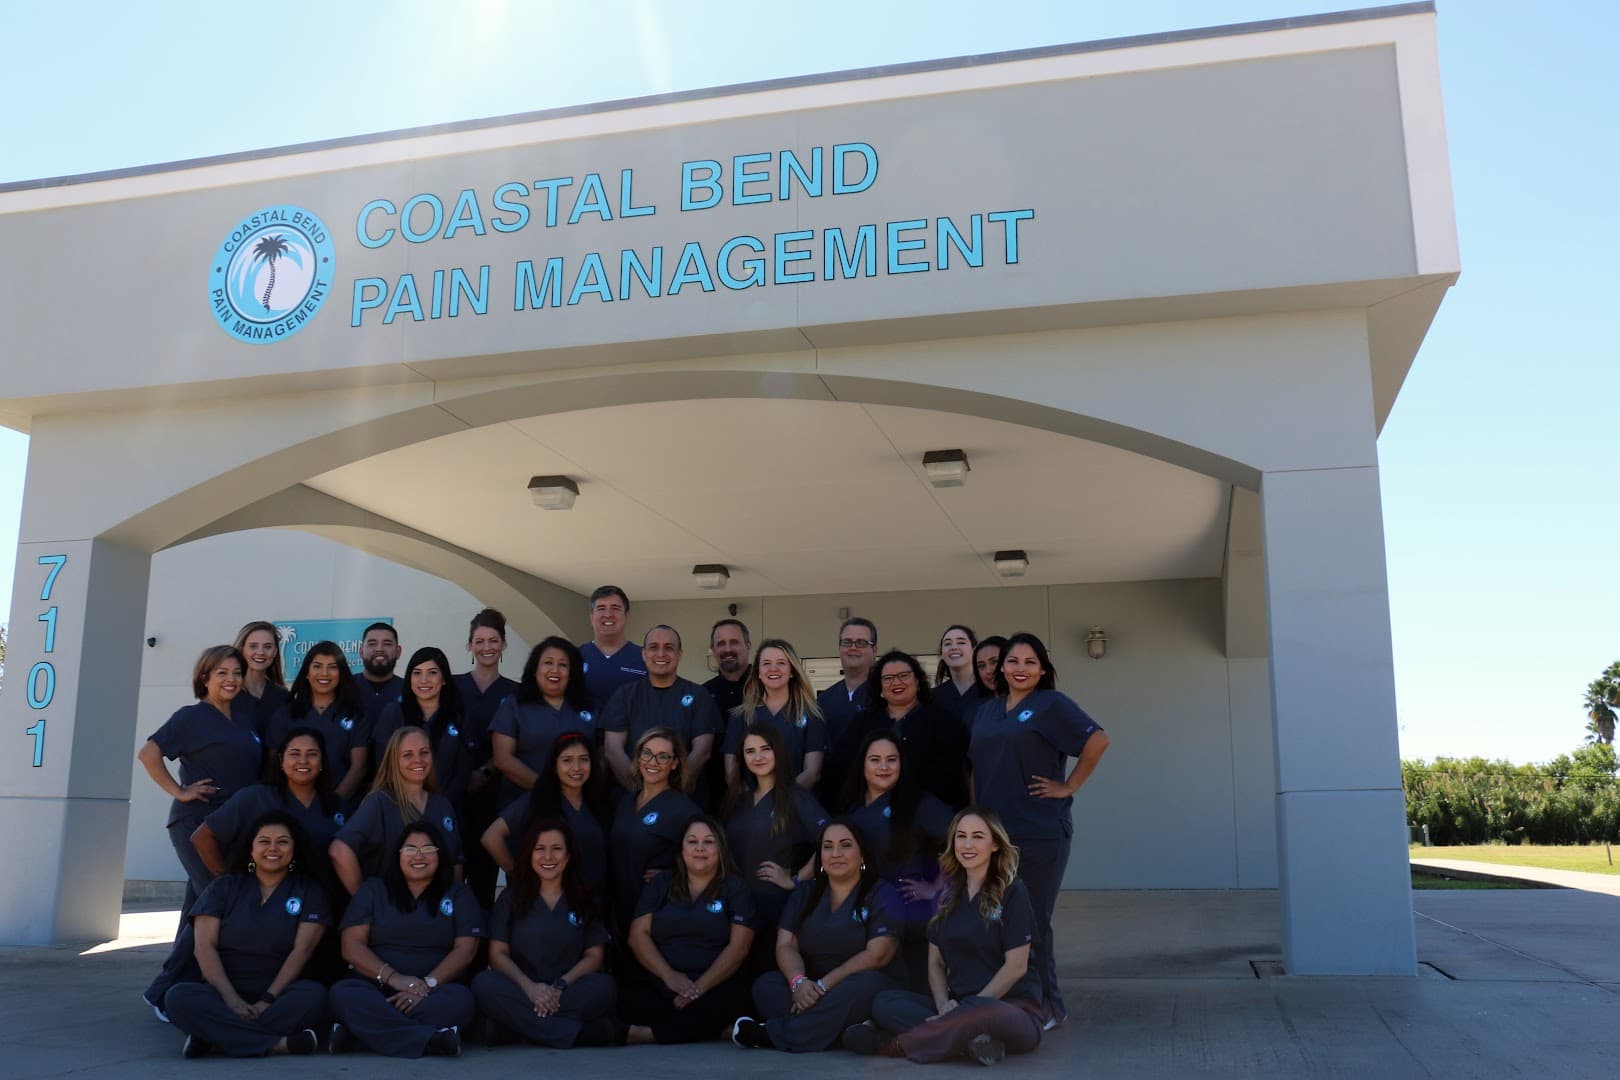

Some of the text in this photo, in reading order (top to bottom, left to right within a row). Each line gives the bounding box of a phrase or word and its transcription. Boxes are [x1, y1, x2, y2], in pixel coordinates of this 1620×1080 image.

[224, 209, 326, 253] COASTAL BEND
[355, 141, 879, 250] COASTAL BEND
[212, 279, 328, 340] PAIN MANAGEMENT
[350, 207, 1035, 328] PAIN MANAGEMENT
[26, 554, 68, 768] 7101
